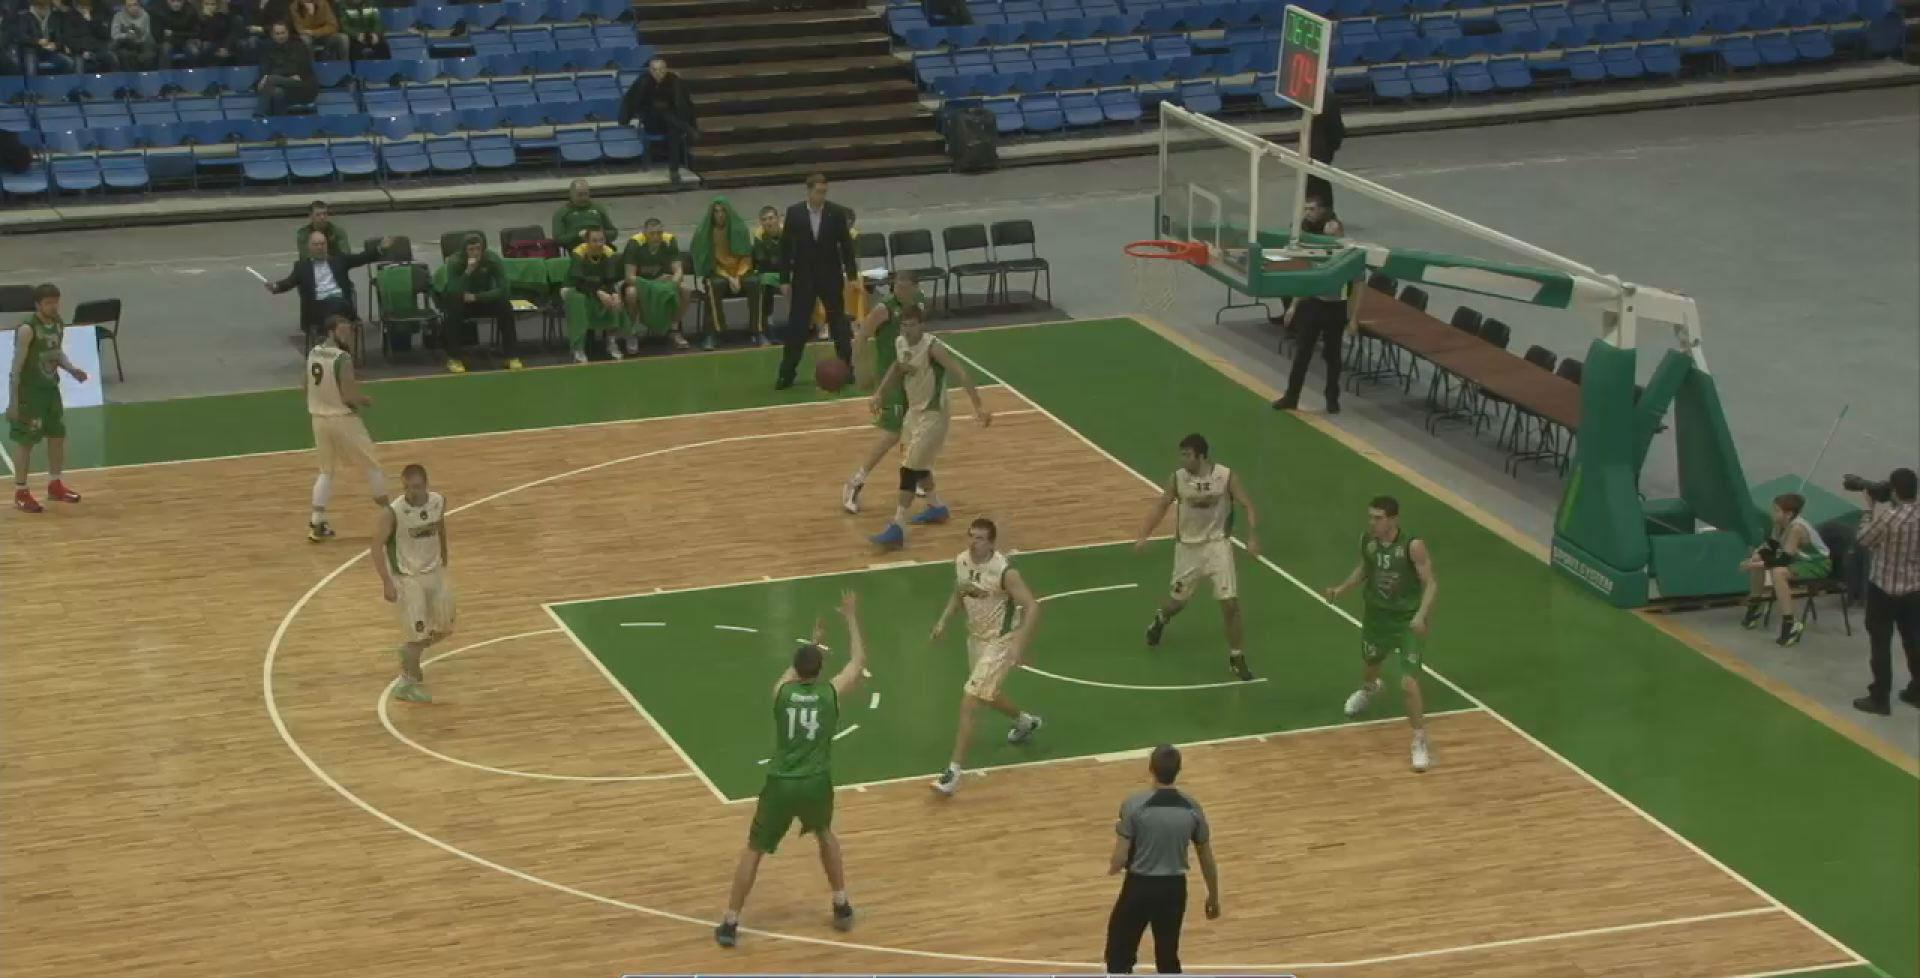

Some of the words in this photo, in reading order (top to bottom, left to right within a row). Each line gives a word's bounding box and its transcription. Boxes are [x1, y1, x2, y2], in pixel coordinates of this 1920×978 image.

[311, 362, 324, 386] 9
[1377, 552, 1391, 569] 15
[785, 707, 820, 740] 14
